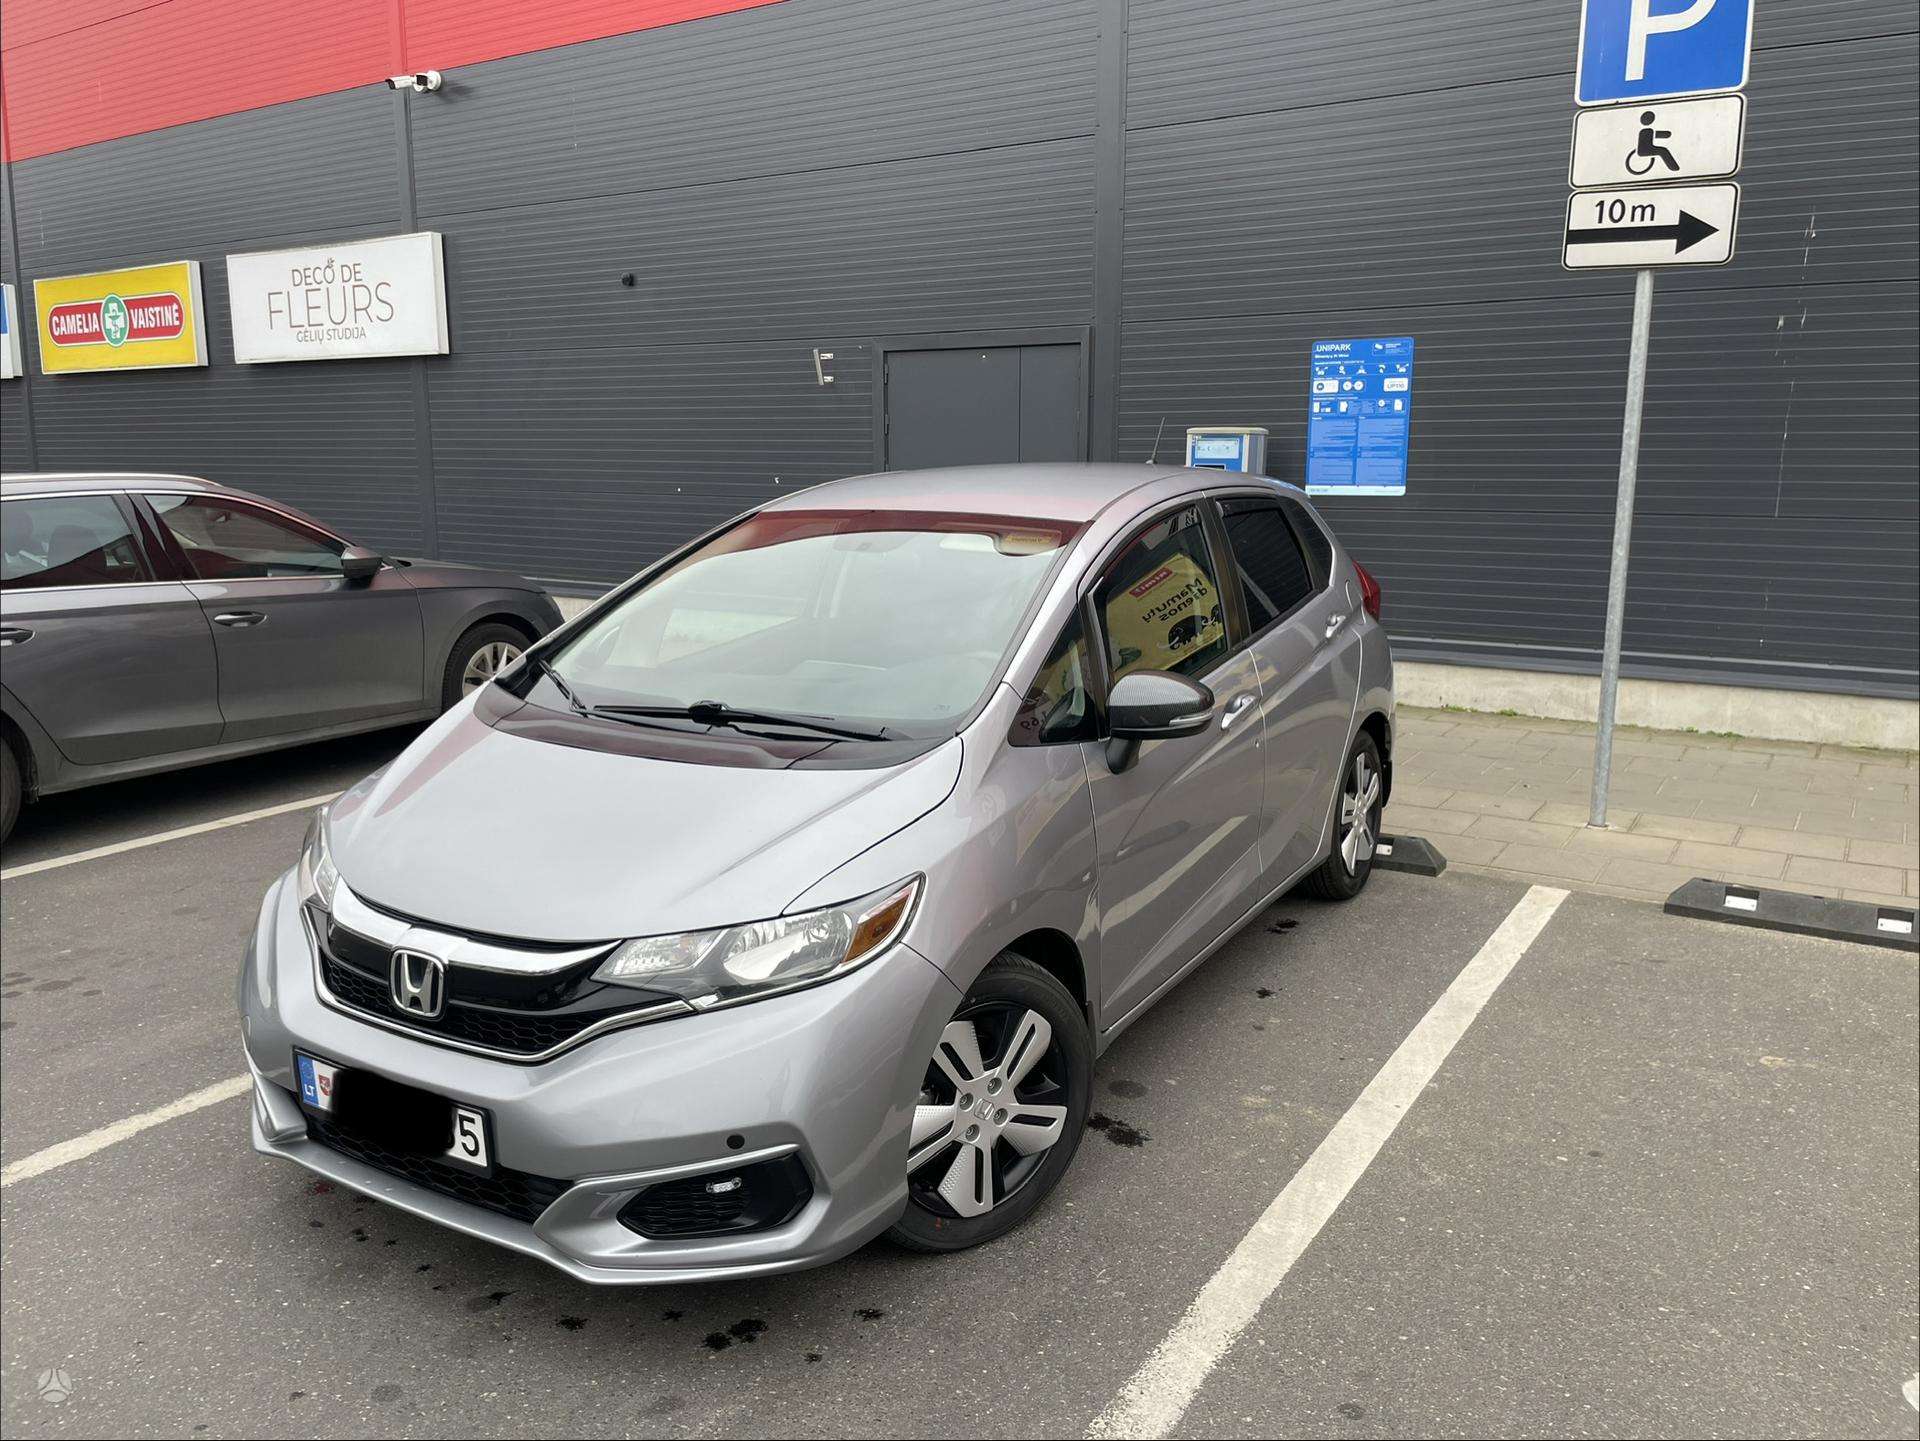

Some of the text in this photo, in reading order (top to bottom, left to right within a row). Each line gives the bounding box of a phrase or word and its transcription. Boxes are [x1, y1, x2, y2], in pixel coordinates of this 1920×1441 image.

[1624, 0, 1718, 81] P
[1595, 198, 1626, 224] 10
[291, 262, 363, 287] DECO DE
[51, 302, 181, 337] CAMELIA VAISTINĖ
[268, 281, 394, 330] FLEURS
[296, 326, 367, 344] GĖLIŲ STUDIJA
[304, 1083, 316, 1097] LT
[458, 1114, 480, 1158] 5
